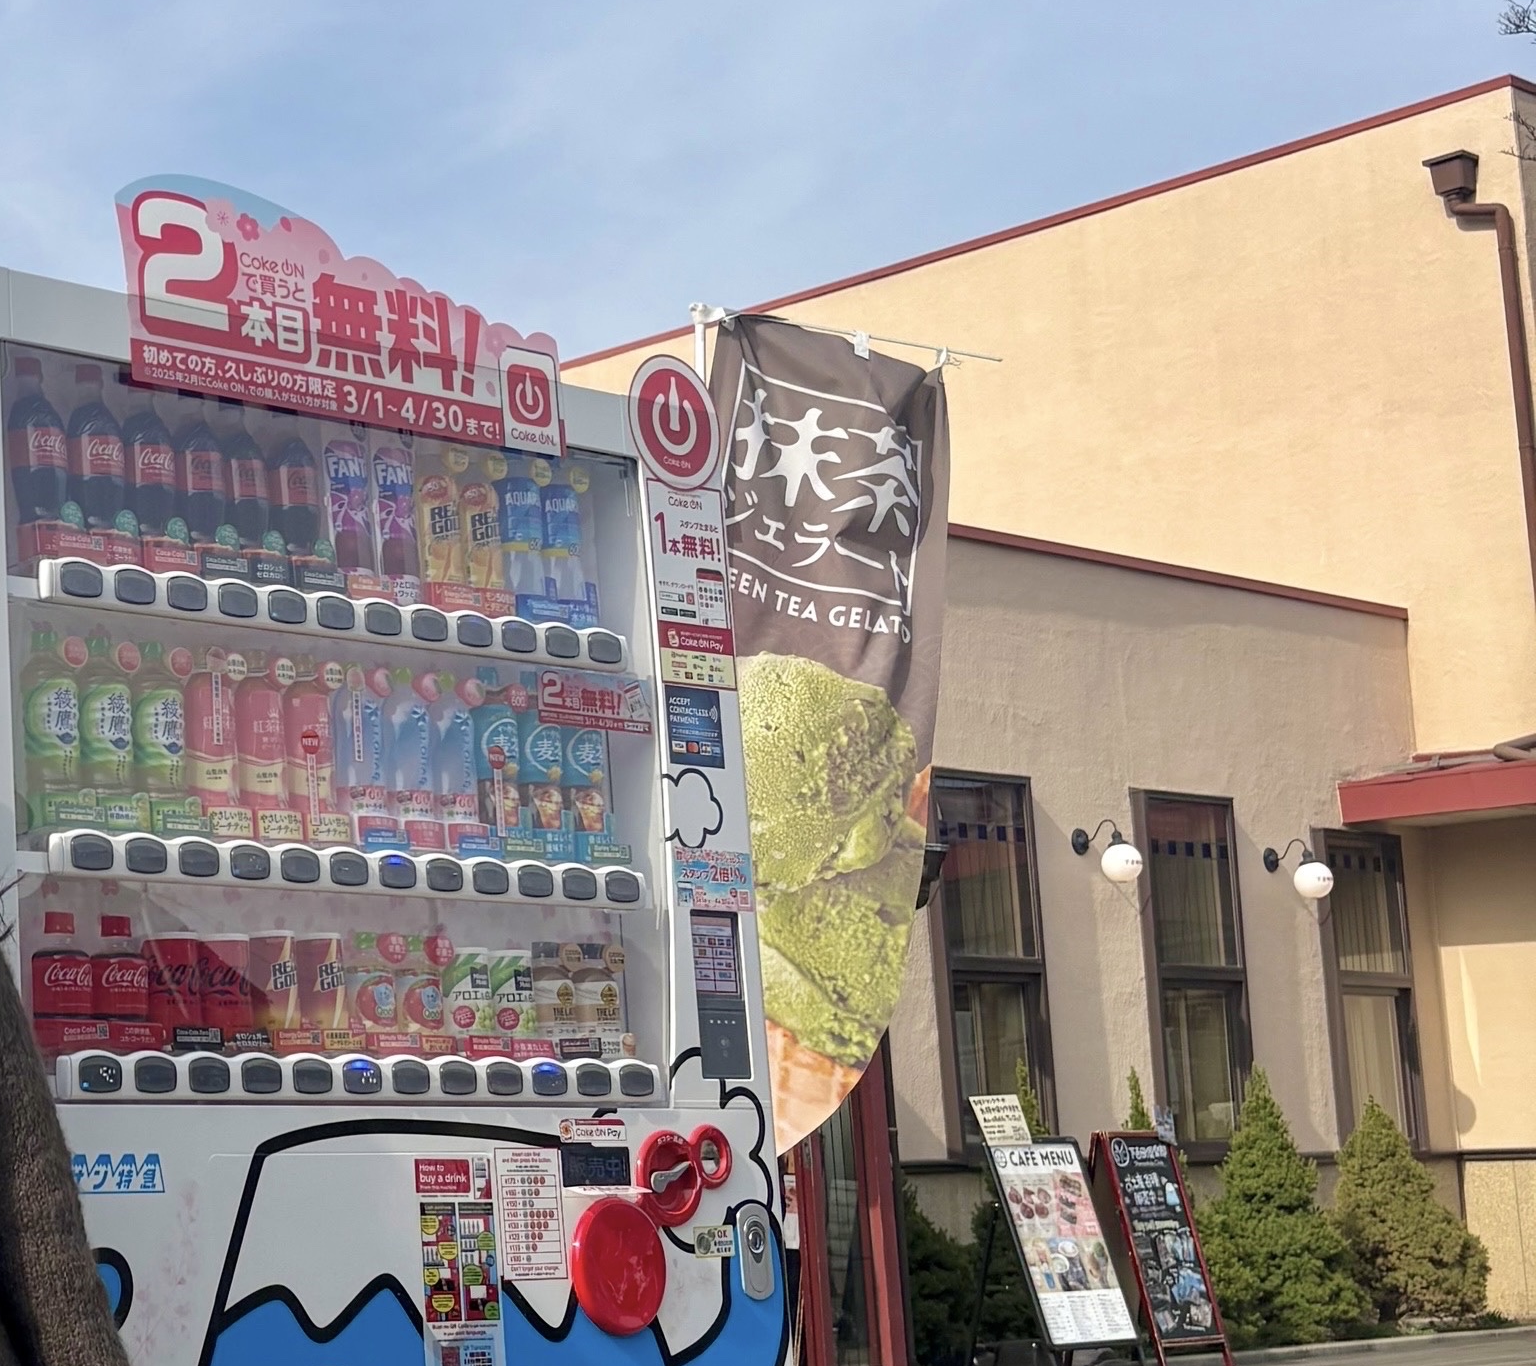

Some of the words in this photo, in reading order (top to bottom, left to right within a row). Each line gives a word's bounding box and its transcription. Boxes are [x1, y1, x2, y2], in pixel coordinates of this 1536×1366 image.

[138, 197, 230, 332] 2
[239, 252, 279, 272] Coke
[281, 258, 306, 280] ON
[241, 272, 306, 303] で買うと
[240, 300, 305, 354] 本目
[312, 272, 481, 398] 無料!
[142, 344, 338, 399] 初めての方、久しぶりの方限定
[510, 427, 537, 444] Coke
[538, 429, 556, 447] ON
[663, 456, 681, 467] Coke
[731, 388, 919, 536] 抹茶
[667, 496, 688, 510] Coke
[689, 497, 703, 511] ON
[679, 519, 720, 534] スタンプたまると
[774, 590, 818, 623] TEA
[828, 604, 911, 644] GELATO
[680, 636, 698, 648] Coke
[698, 637, 709, 648] ON
[709, 639, 724, 653] Pay
[542, 671, 563, 706] 2
[54, 687, 74, 731] 綾鷹
[669, 696, 691, 706] ACCEPT
[669, 705, 709, 717] CONTACTLESS
[107, 692, 127, 736] 綾鷹
[161, 697, 181, 741] 綾鷹
[669, 714, 700, 725] PAYMENTS
[575, 1127, 595, 1137] Coke
[596, 1127, 607, 1137] ON
[607, 1128, 622, 1139] Pay
[569, 1156, 622, 1177] 販売中
[1039, 1149, 1074, 1166] MENU
[419, 1164, 435, 1172] How
[420, 1173, 436, 1184] buy
[445, 1173, 467, 1183] drink
[717, 1229, 728, 1238] OK
